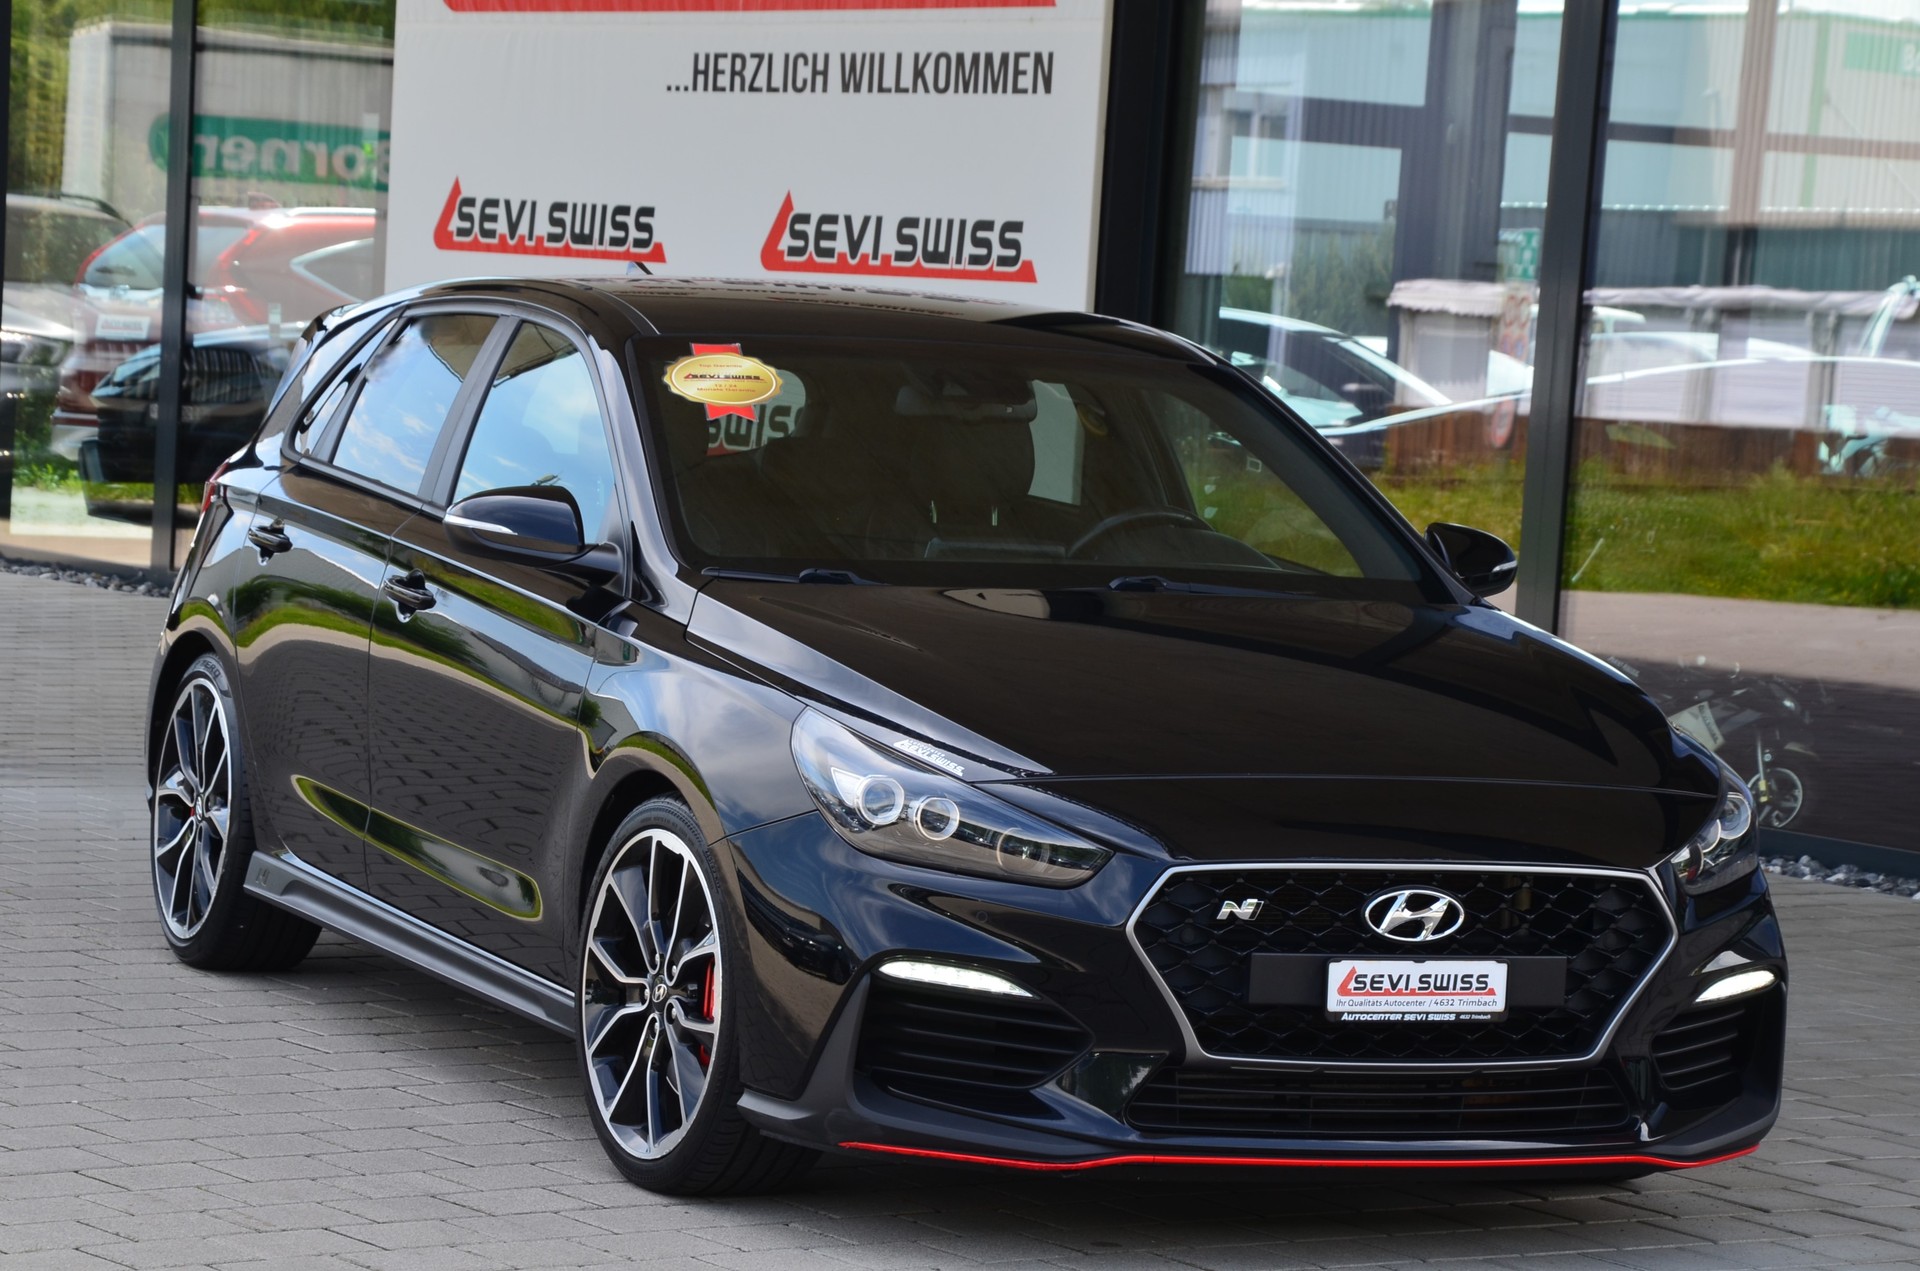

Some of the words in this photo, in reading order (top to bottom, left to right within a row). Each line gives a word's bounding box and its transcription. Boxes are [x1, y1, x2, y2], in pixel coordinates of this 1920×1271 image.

[666, 52, 830, 94] ...HERZLICH
[840, 51, 1054, 95] WILLKOMMEN
[456, 197, 537, 242] SEVI
[546, 202, 655, 249] SWISS
[787, 213, 883, 261] SEVI
[894, 217, 1024, 268] SWISS
[928, 753, 965, 774] SWISS
[1353, 974, 1411, 993] SEVI
[1417, 973, 1489, 993] SWISS
[1336, 999, 1347, 1007] Ihr
[1384, 999, 1426, 1007] Autocenter
[1457, 998, 1498, 1008] Trimbach
[1403, 1013, 1427, 1021] SEVI
[1427, 1013, 1457, 1021] SWISS
